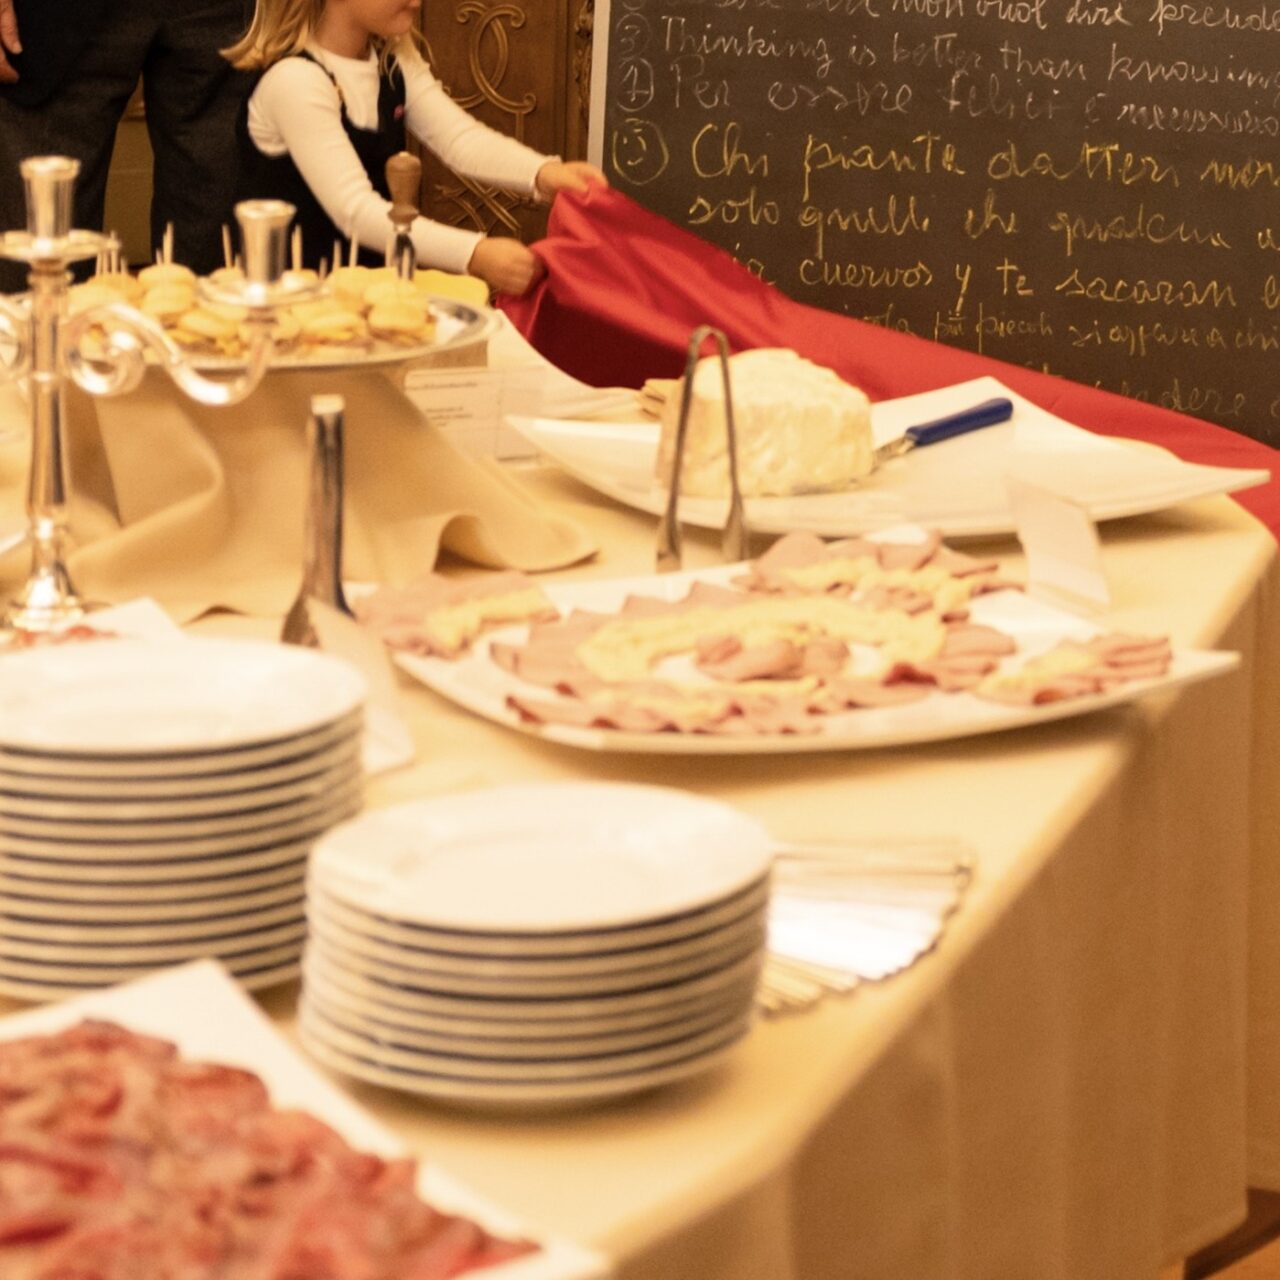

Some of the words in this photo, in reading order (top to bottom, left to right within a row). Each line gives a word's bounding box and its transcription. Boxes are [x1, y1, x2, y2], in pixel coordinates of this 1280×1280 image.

[661, 15, 833, 79] Thinking
[846, 33, 878, 67] is
[892, 31, 984, 70] better
[1000, 39, 1087, 82] than
[670, 55, 731, 109] Per
[767, 80, 913, 112] essere
[692, 122, 768, 179] Chi
[688, 187, 780, 225] solo
[800, 194, 930, 258] quelli
[965, 187, 1017, 238] che
[800, 257, 933, 289] cuervos
[954, 262, 972, 316] y
[996, 258, 1034, 297] te
